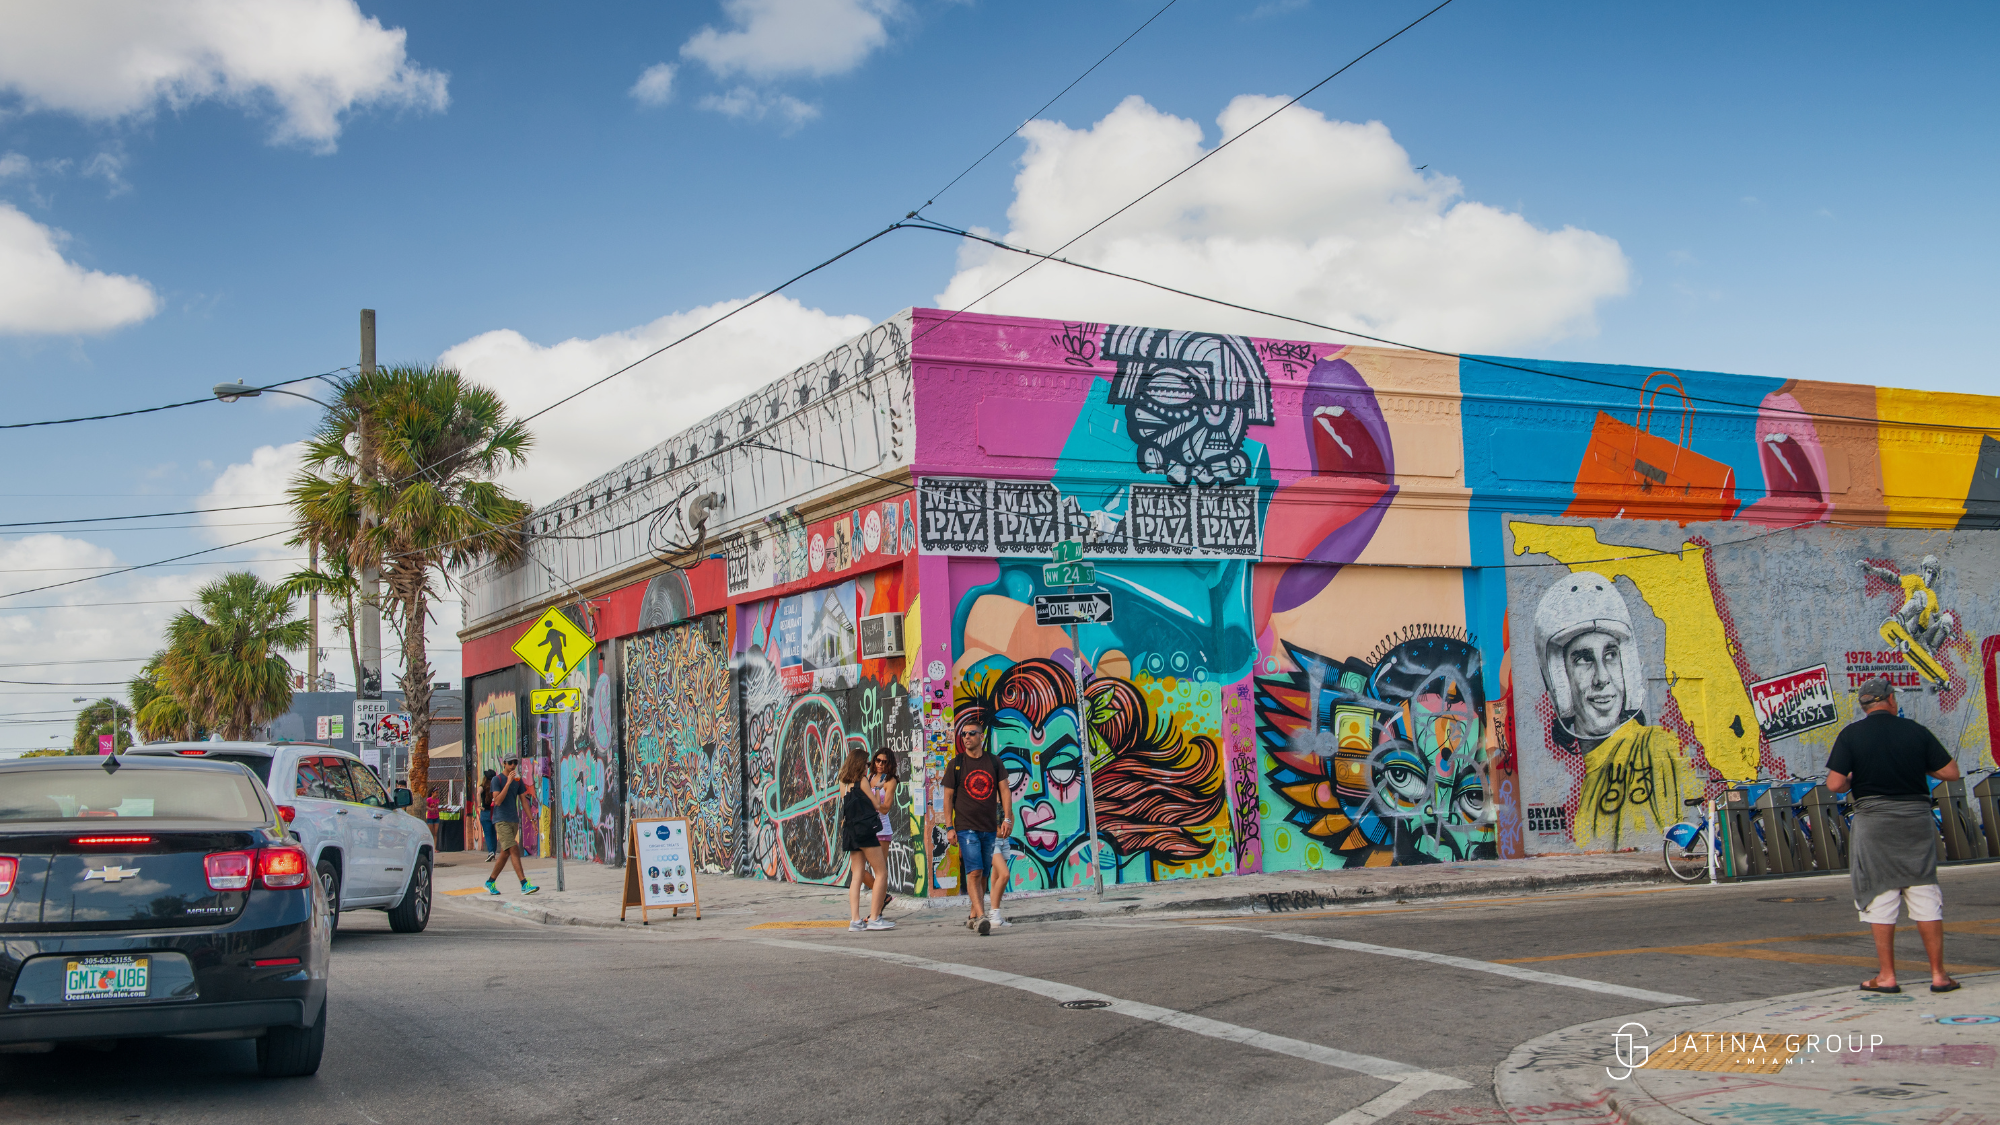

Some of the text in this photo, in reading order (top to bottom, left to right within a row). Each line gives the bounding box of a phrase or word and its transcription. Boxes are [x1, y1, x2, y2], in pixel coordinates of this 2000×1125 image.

[925, 487, 982, 511] MAS
[998, 489, 1053, 514] MAS
[1135, 493, 1187, 518] MAS
[1200, 496, 1251, 518] MAS
[925, 510, 984, 540] PAZ
[999, 513, 1055, 543] PAZ
[1136, 516, 1189, 545] PAZ
[1201, 517, 1253, 546] PAZ
[1063, 544, 1068, 561] 2
[729, 556, 748, 585] PAZ
[1046, 567, 1094, 583] NW 24 ST
[1050, 604, 1069, 616] ONE
[1078, 602, 1099, 615] WAY
[1845, 650, 1904, 664] 1978-2018
[357, 704, 386, 712] SPEED
[1757, 670, 1829, 730] Skateboard
[1797, 703, 1828, 725] USA
[1527, 806, 1566, 819] BRYAN
[1528, 819, 1567, 831] DEESE
[84, 956, 132, 965] 305-633-3155
[68, 968, 146, 990] GMI U86
[65, 991, 146, 1001] OceanAutoSales.com
